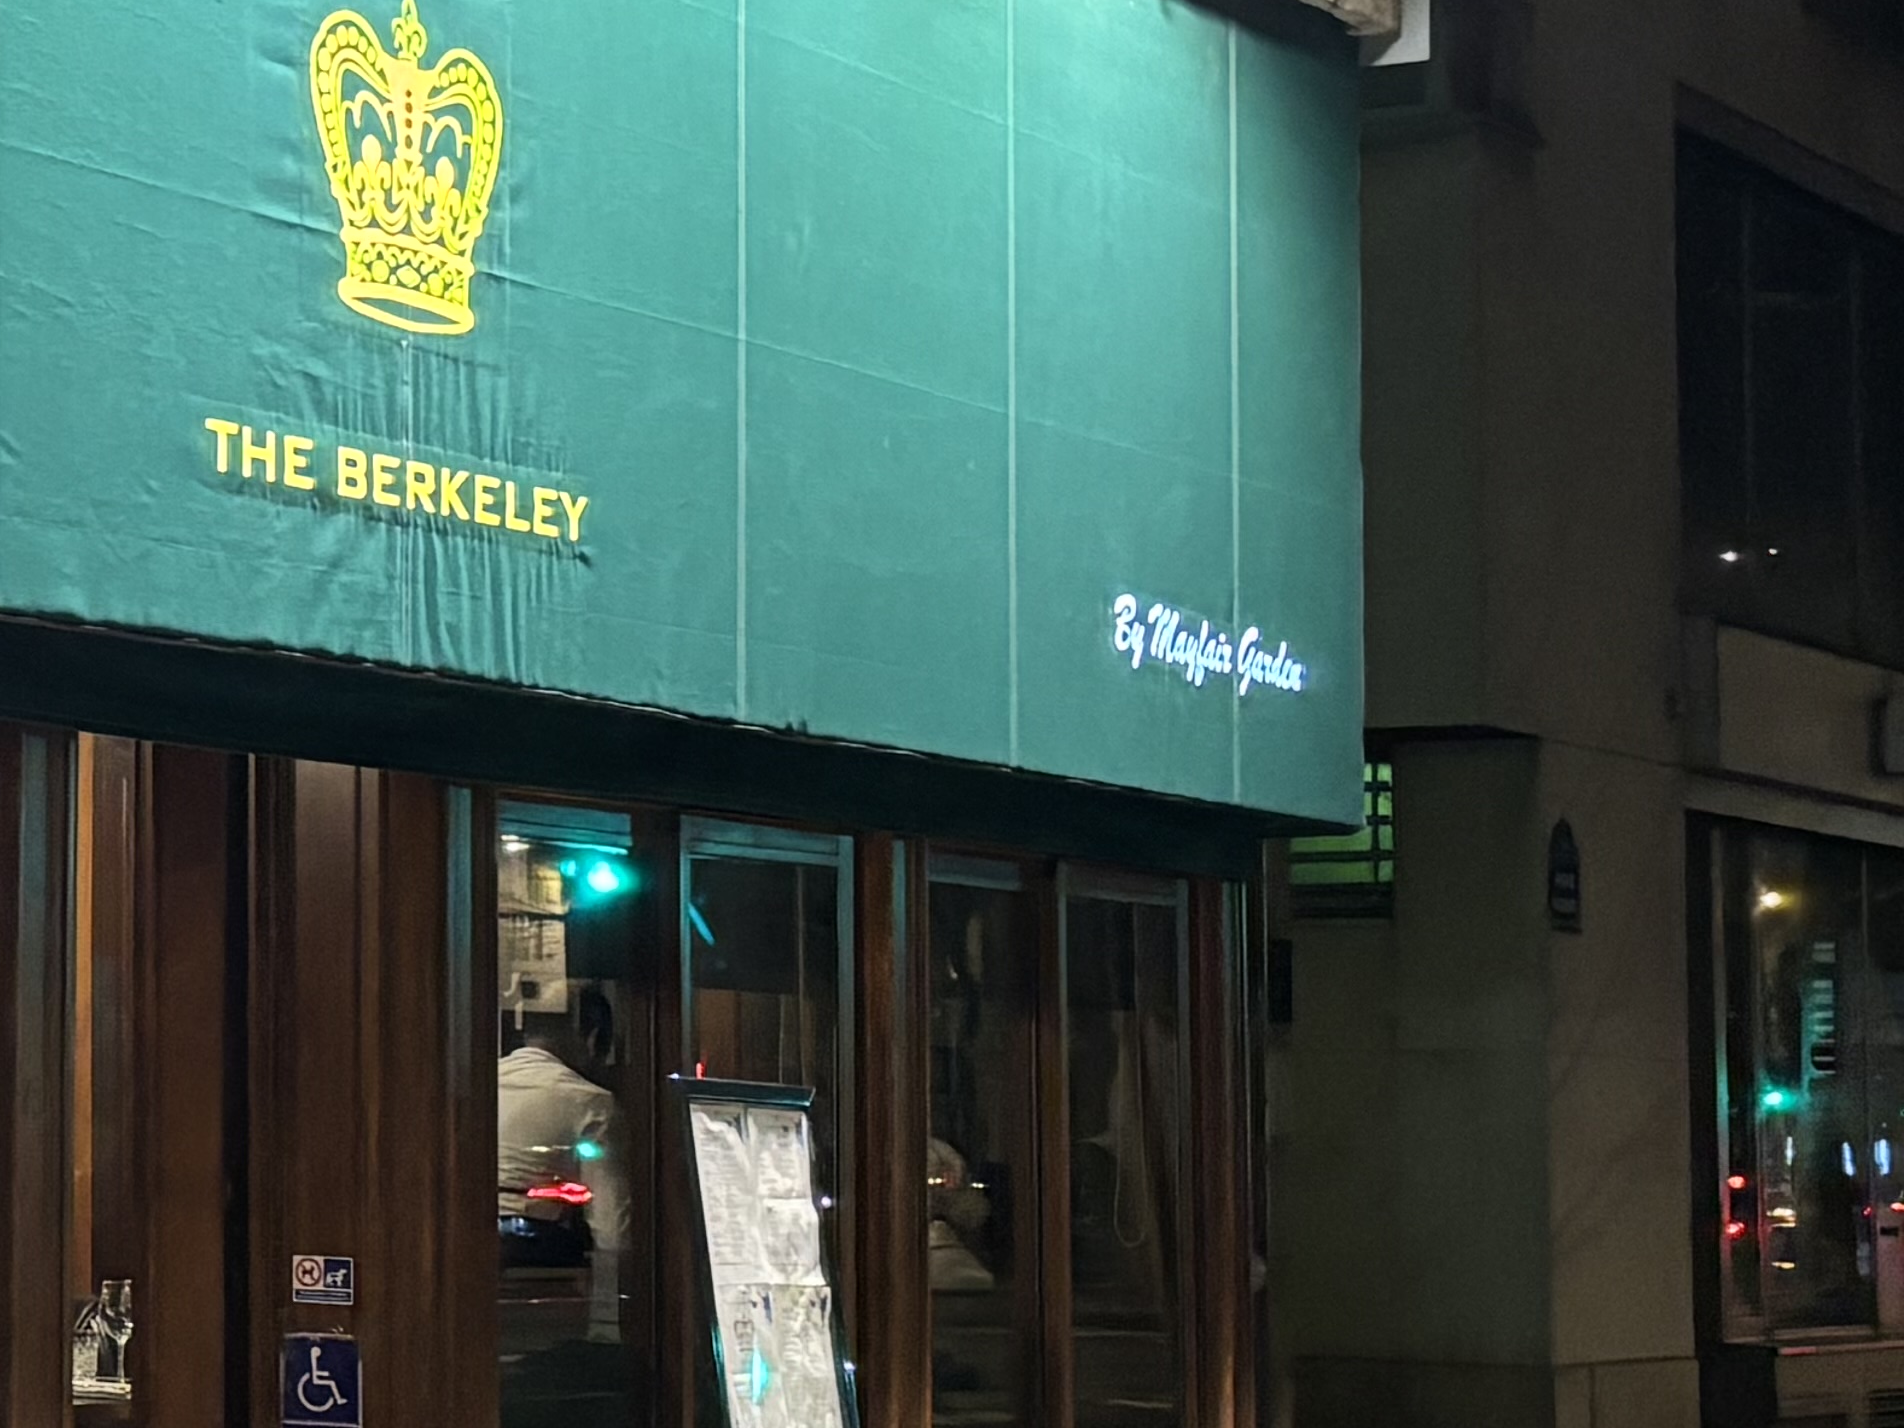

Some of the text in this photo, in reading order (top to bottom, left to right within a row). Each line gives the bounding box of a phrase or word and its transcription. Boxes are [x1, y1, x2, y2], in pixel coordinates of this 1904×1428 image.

[204, 417, 589, 541] THE BERKELEY
[1113, 593, 1303, 697] By Mayfair Garden
